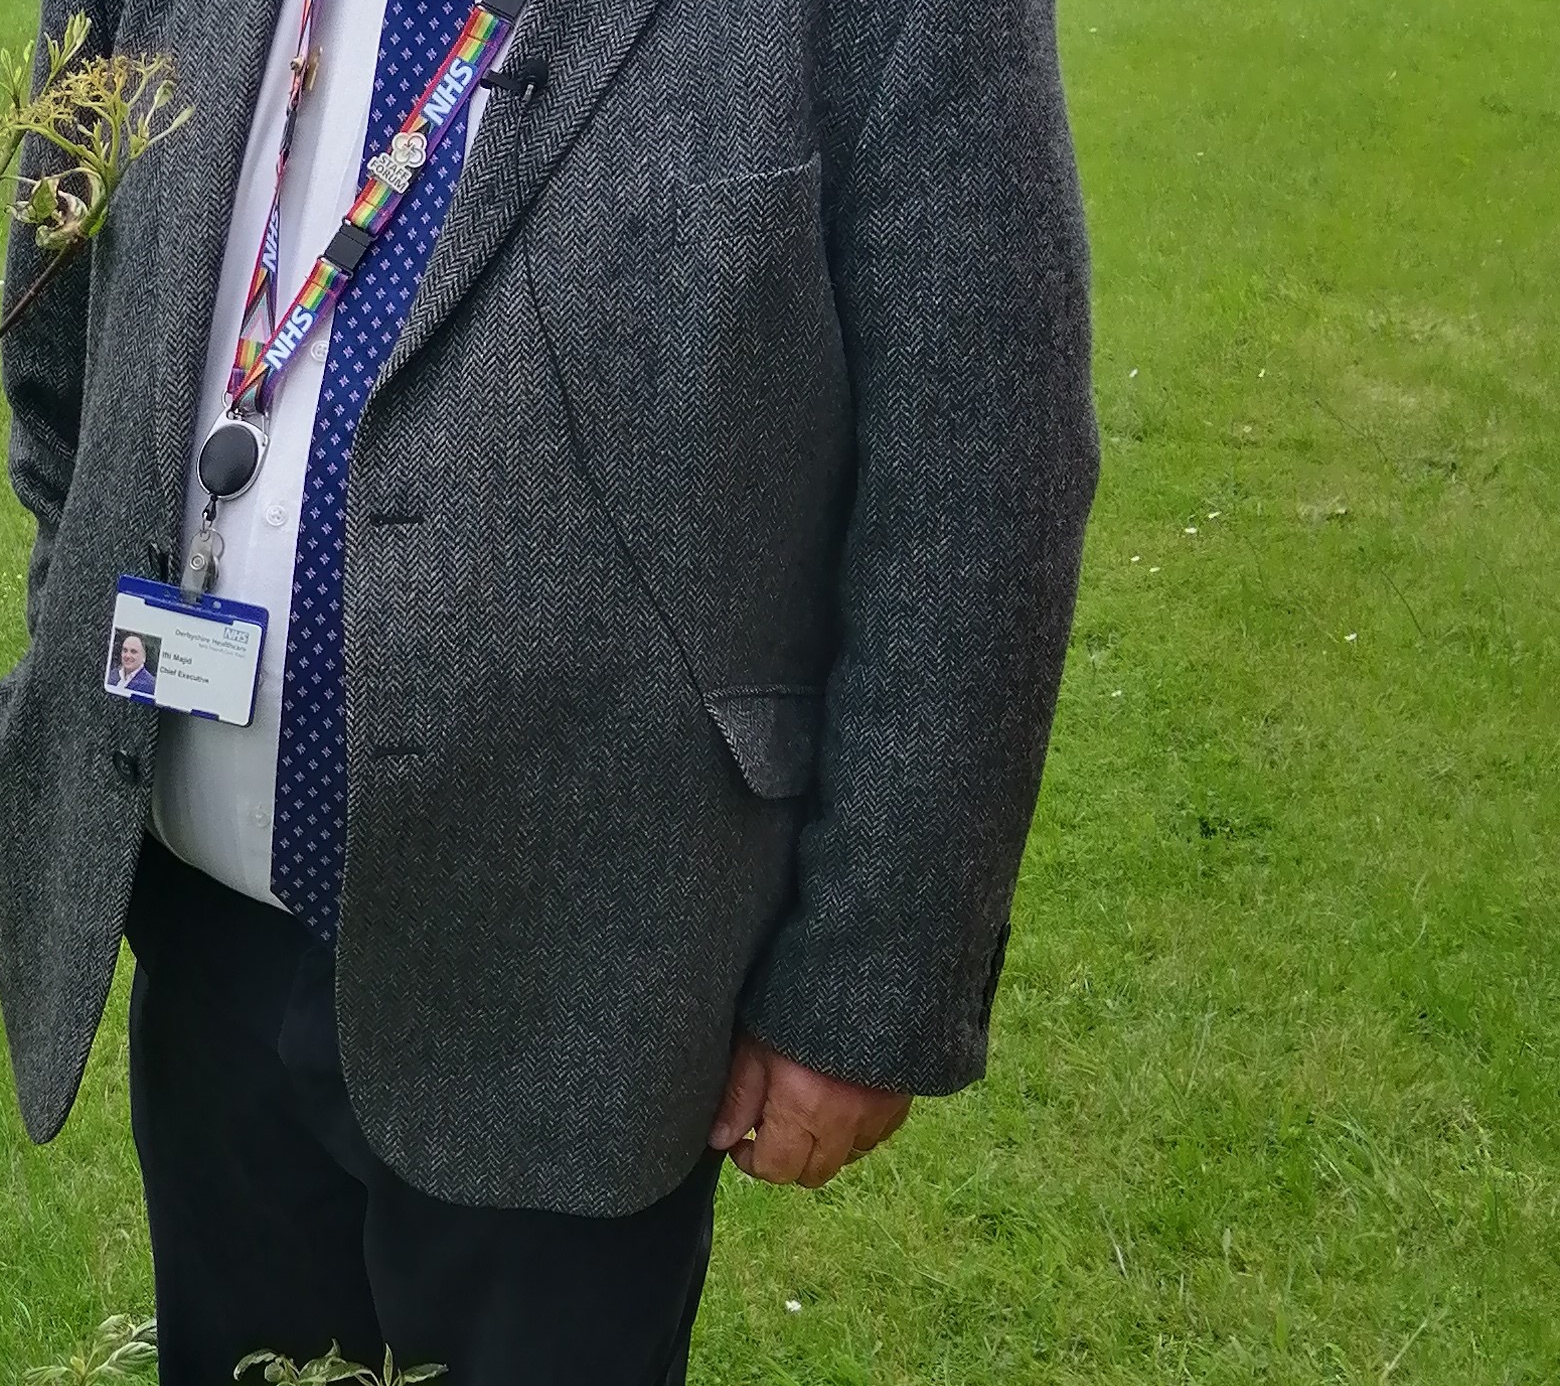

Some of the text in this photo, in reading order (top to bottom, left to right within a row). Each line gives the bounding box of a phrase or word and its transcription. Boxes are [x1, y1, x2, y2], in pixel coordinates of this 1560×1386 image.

[423, 57, 473, 126] NHS
[370, 159, 407, 191] FORUM
[379, 154, 409, 180] STAFF
[266, 305, 314, 370] NHS
[175, 628, 210, 643] Derbyshire
[224, 627, 249, 644] NHS
[160, 665, 177, 676] Chief
